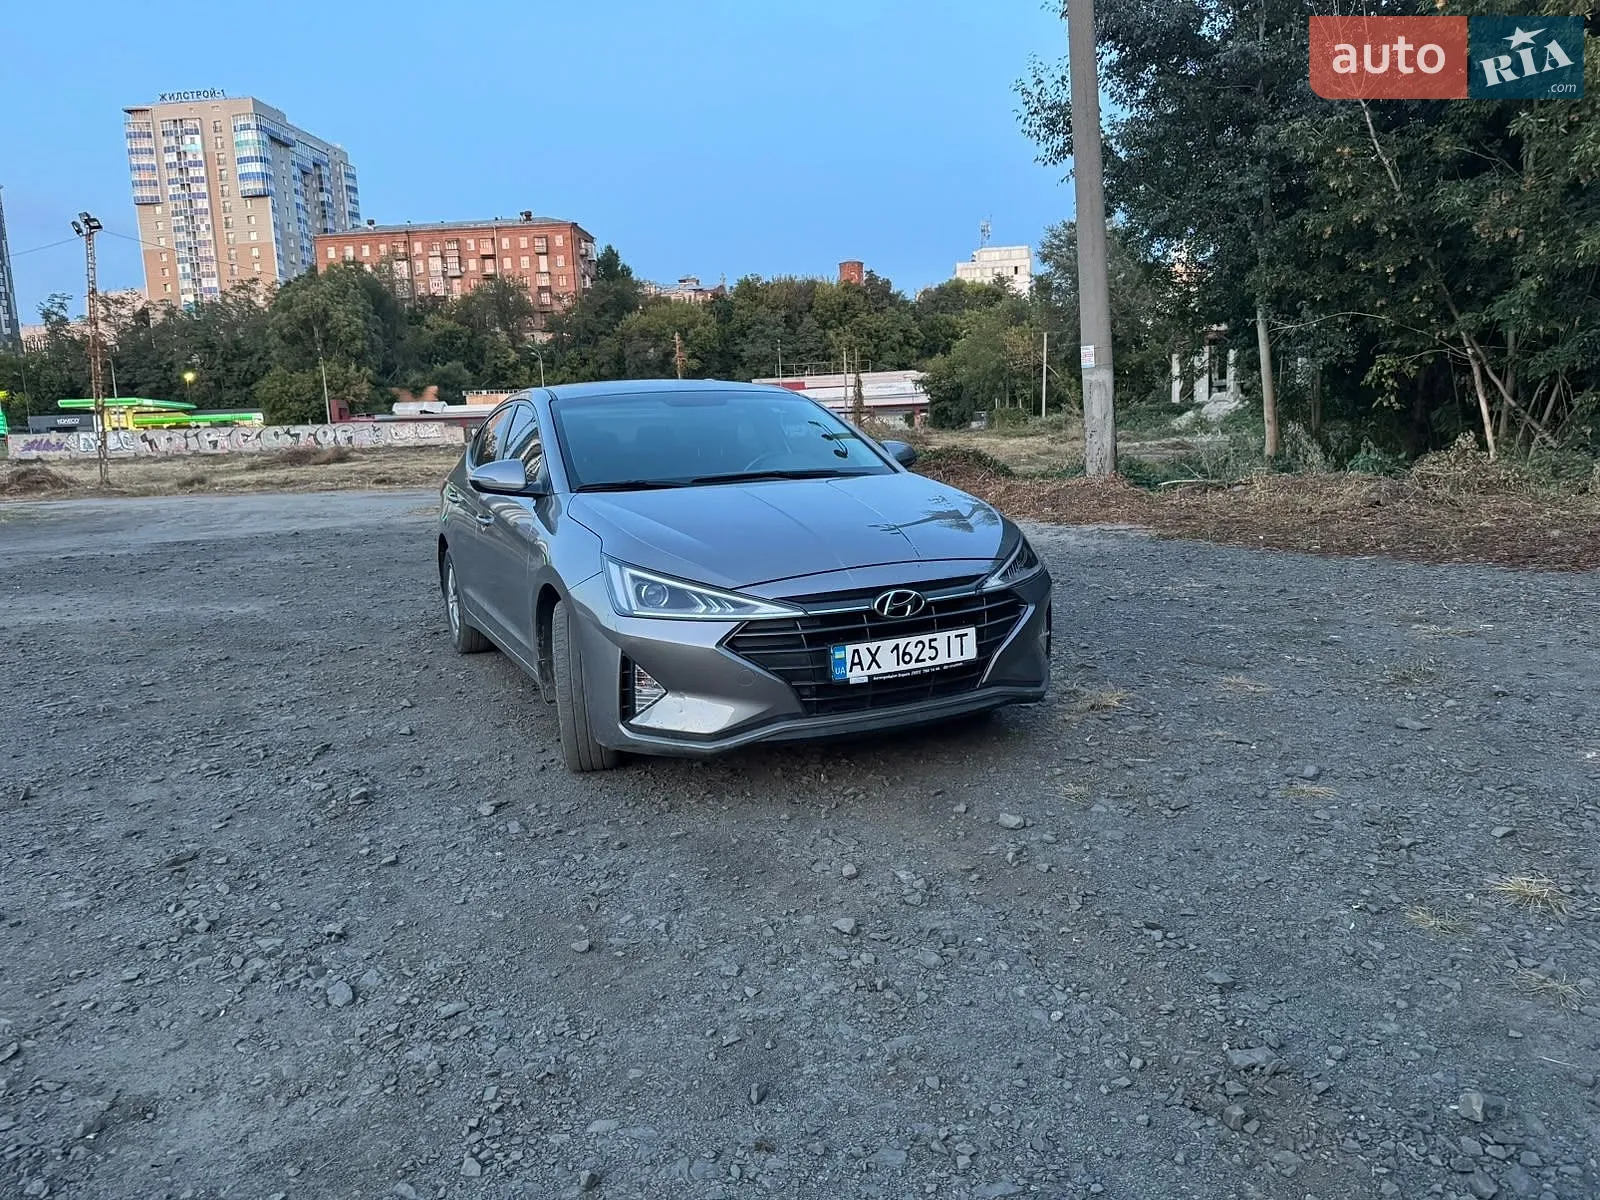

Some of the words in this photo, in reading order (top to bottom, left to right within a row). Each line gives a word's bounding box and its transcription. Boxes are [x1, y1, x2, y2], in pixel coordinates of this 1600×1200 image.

[159, 87, 226, 102] ЖИЛСТРОЙ-1
[849, 645, 882, 673] AX
[890, 637, 939, 667] 1625
[947, 633, 969, 658] IT
[835, 665, 846, 675] UA
